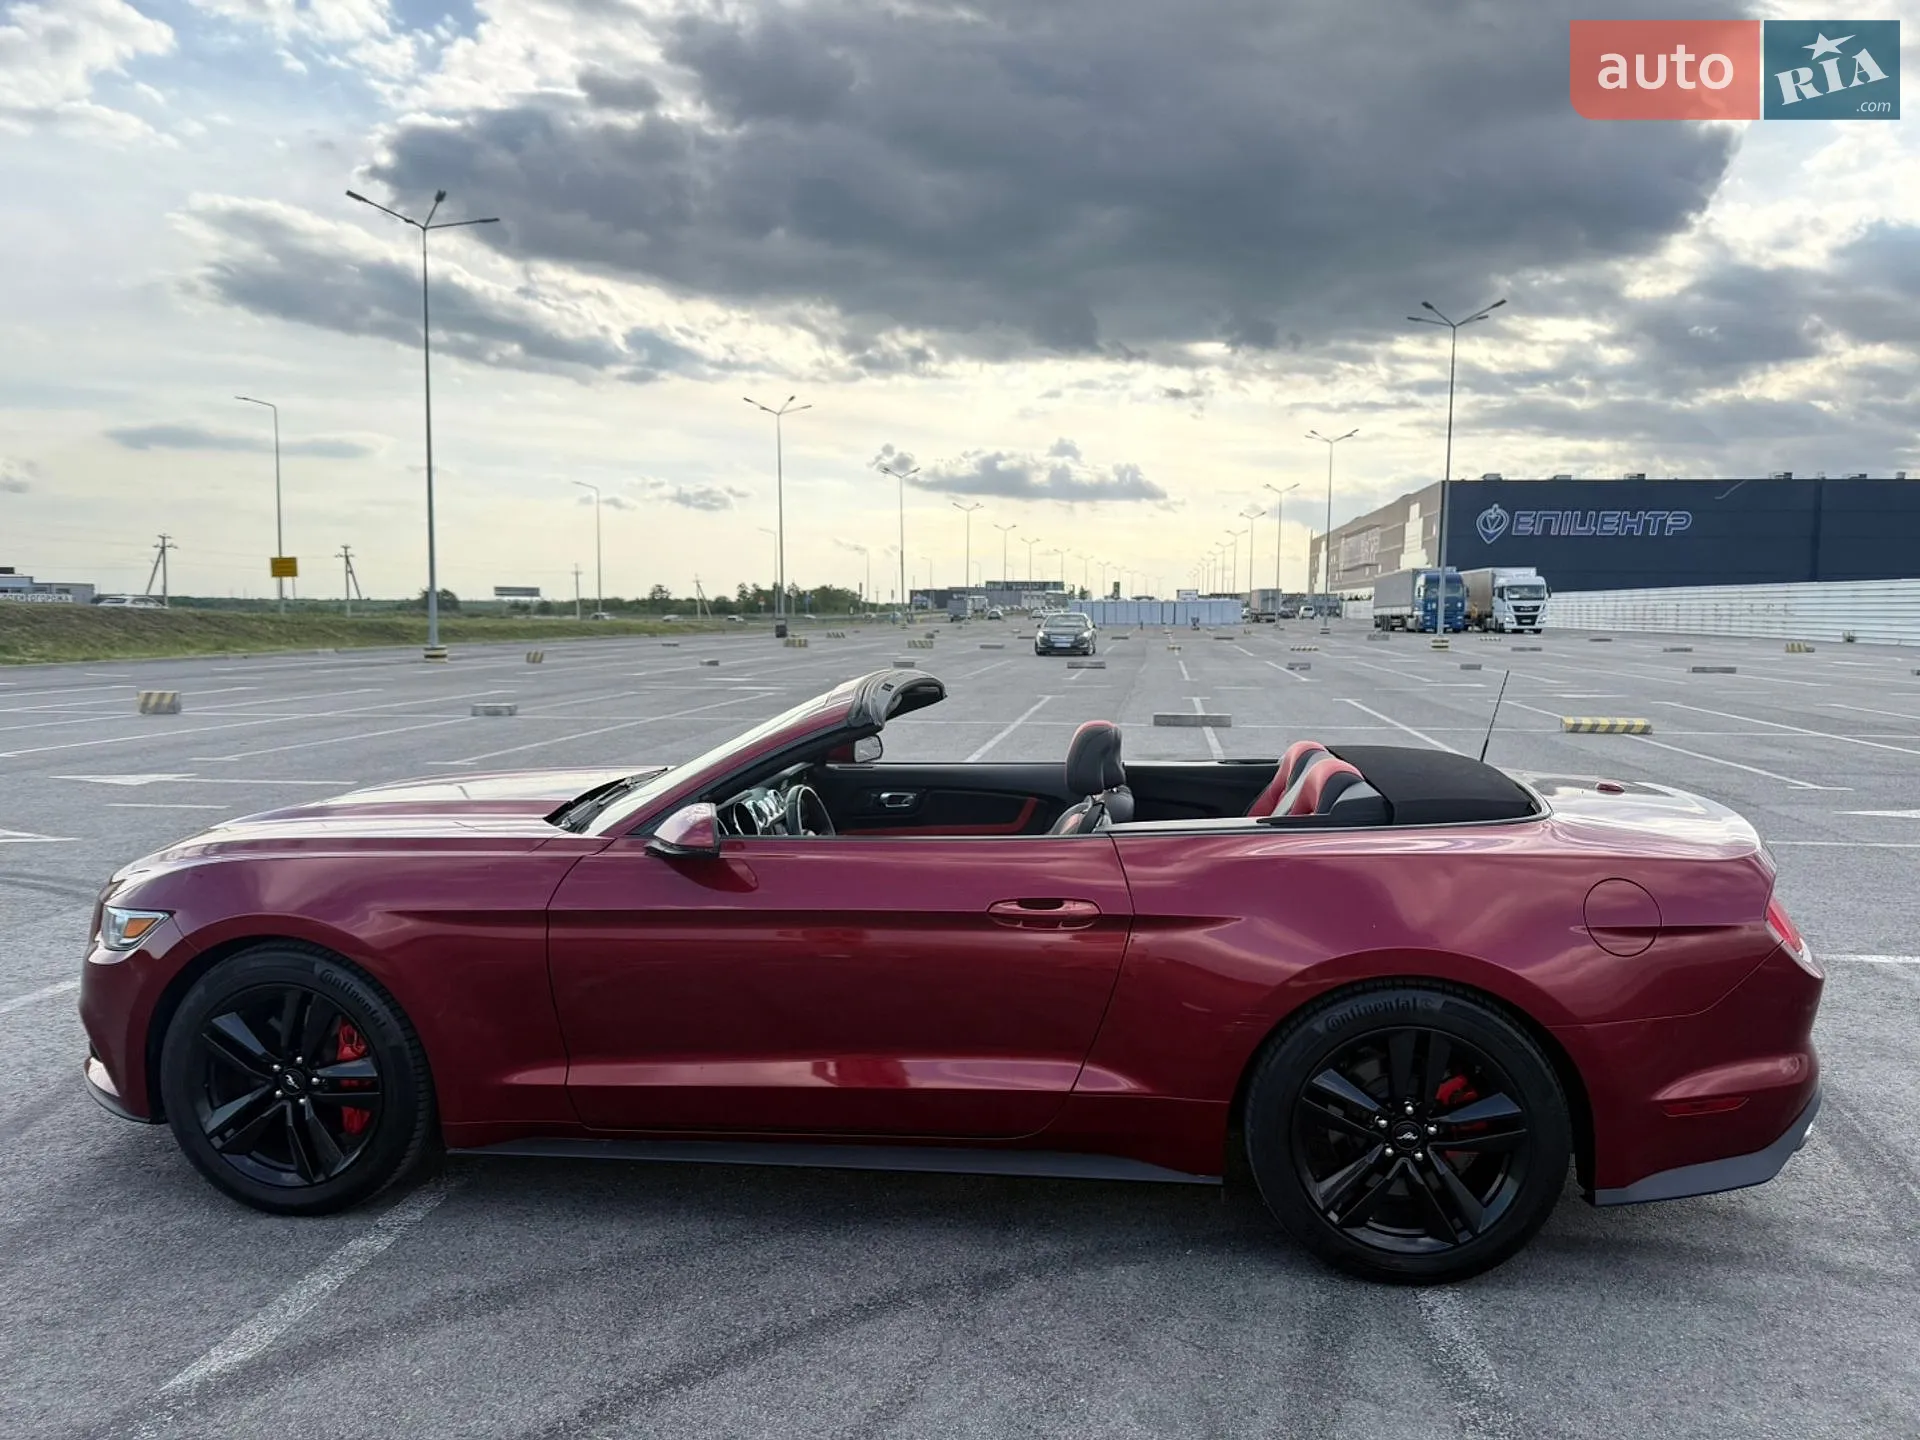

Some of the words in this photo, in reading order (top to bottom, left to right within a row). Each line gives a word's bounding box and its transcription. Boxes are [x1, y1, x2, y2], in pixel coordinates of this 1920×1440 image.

[1511, 510, 1693, 536] ЕПІЦЕНТР
[320, 968, 387, 1029] Continental
[1325, 997, 1418, 1033] Continental
